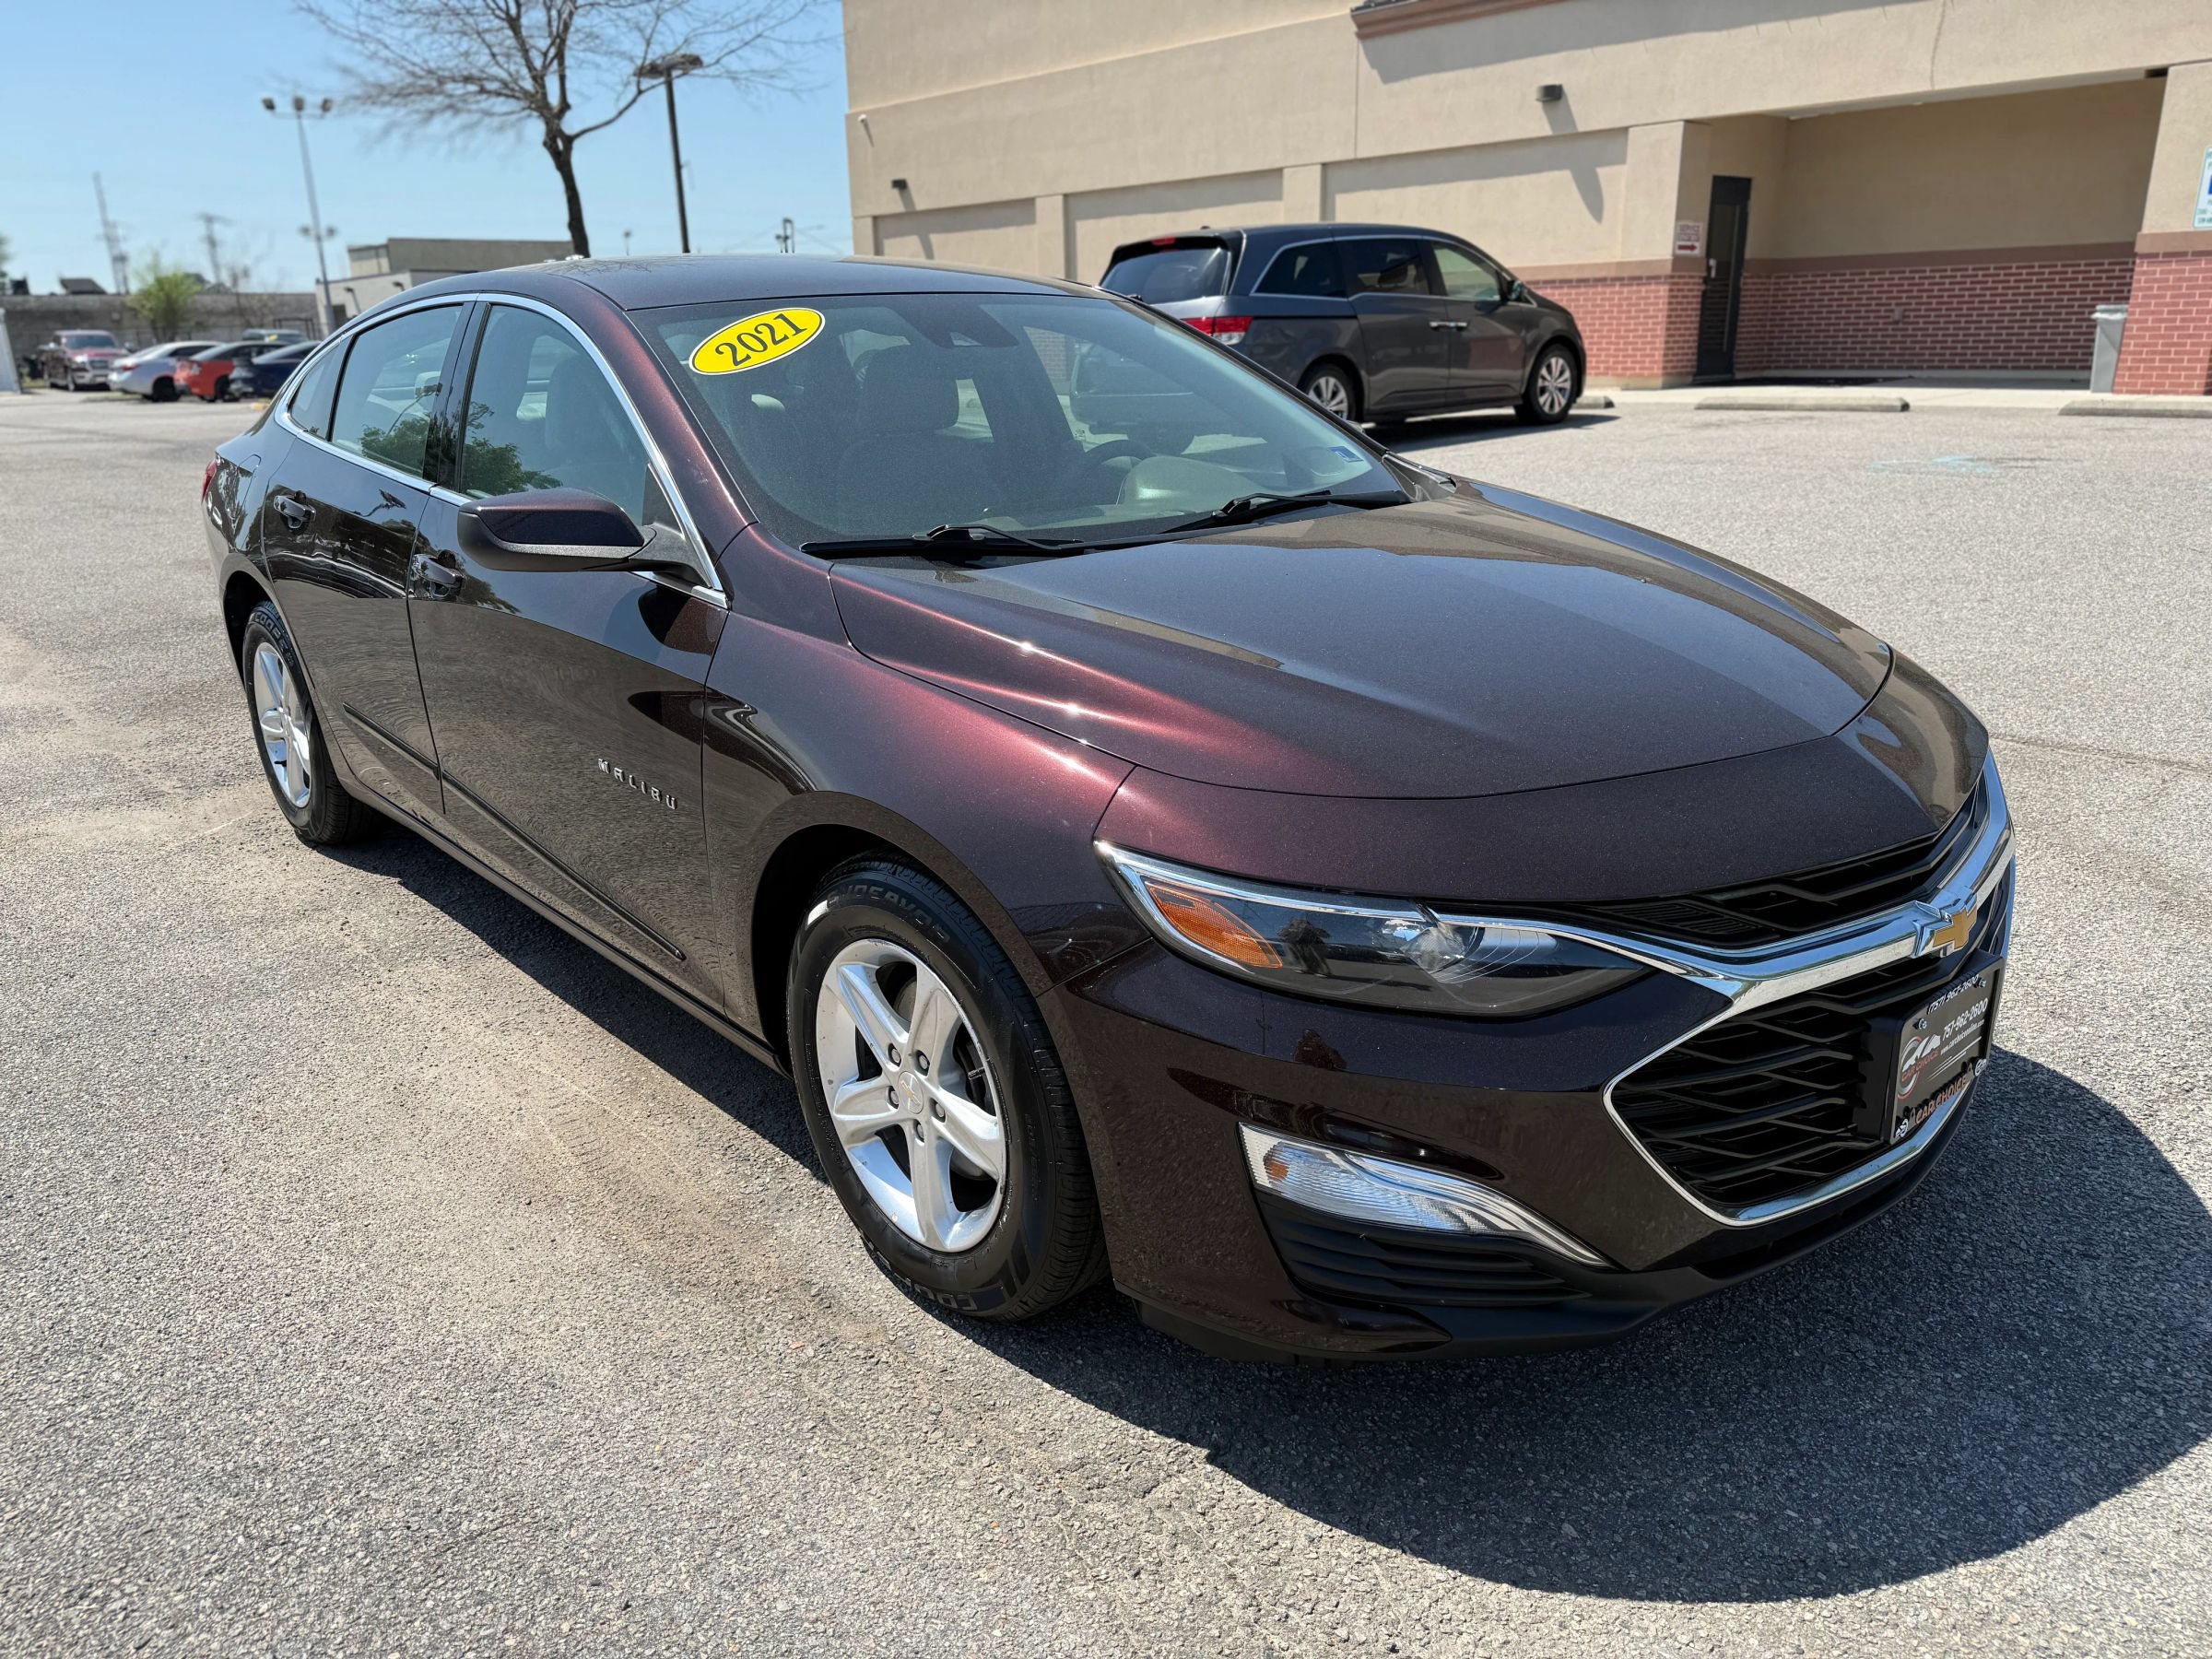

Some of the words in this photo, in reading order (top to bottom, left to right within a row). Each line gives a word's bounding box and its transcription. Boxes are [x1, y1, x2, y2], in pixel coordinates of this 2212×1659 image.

[715, 313, 807, 366] 2021
[598, 759, 676, 809] MALIBU
[1942, 997, 1988, 1041] 757-962-2600
[1916, 1100, 1936, 1124] CAR
[1936, 1075, 1967, 1107] CHOICE
